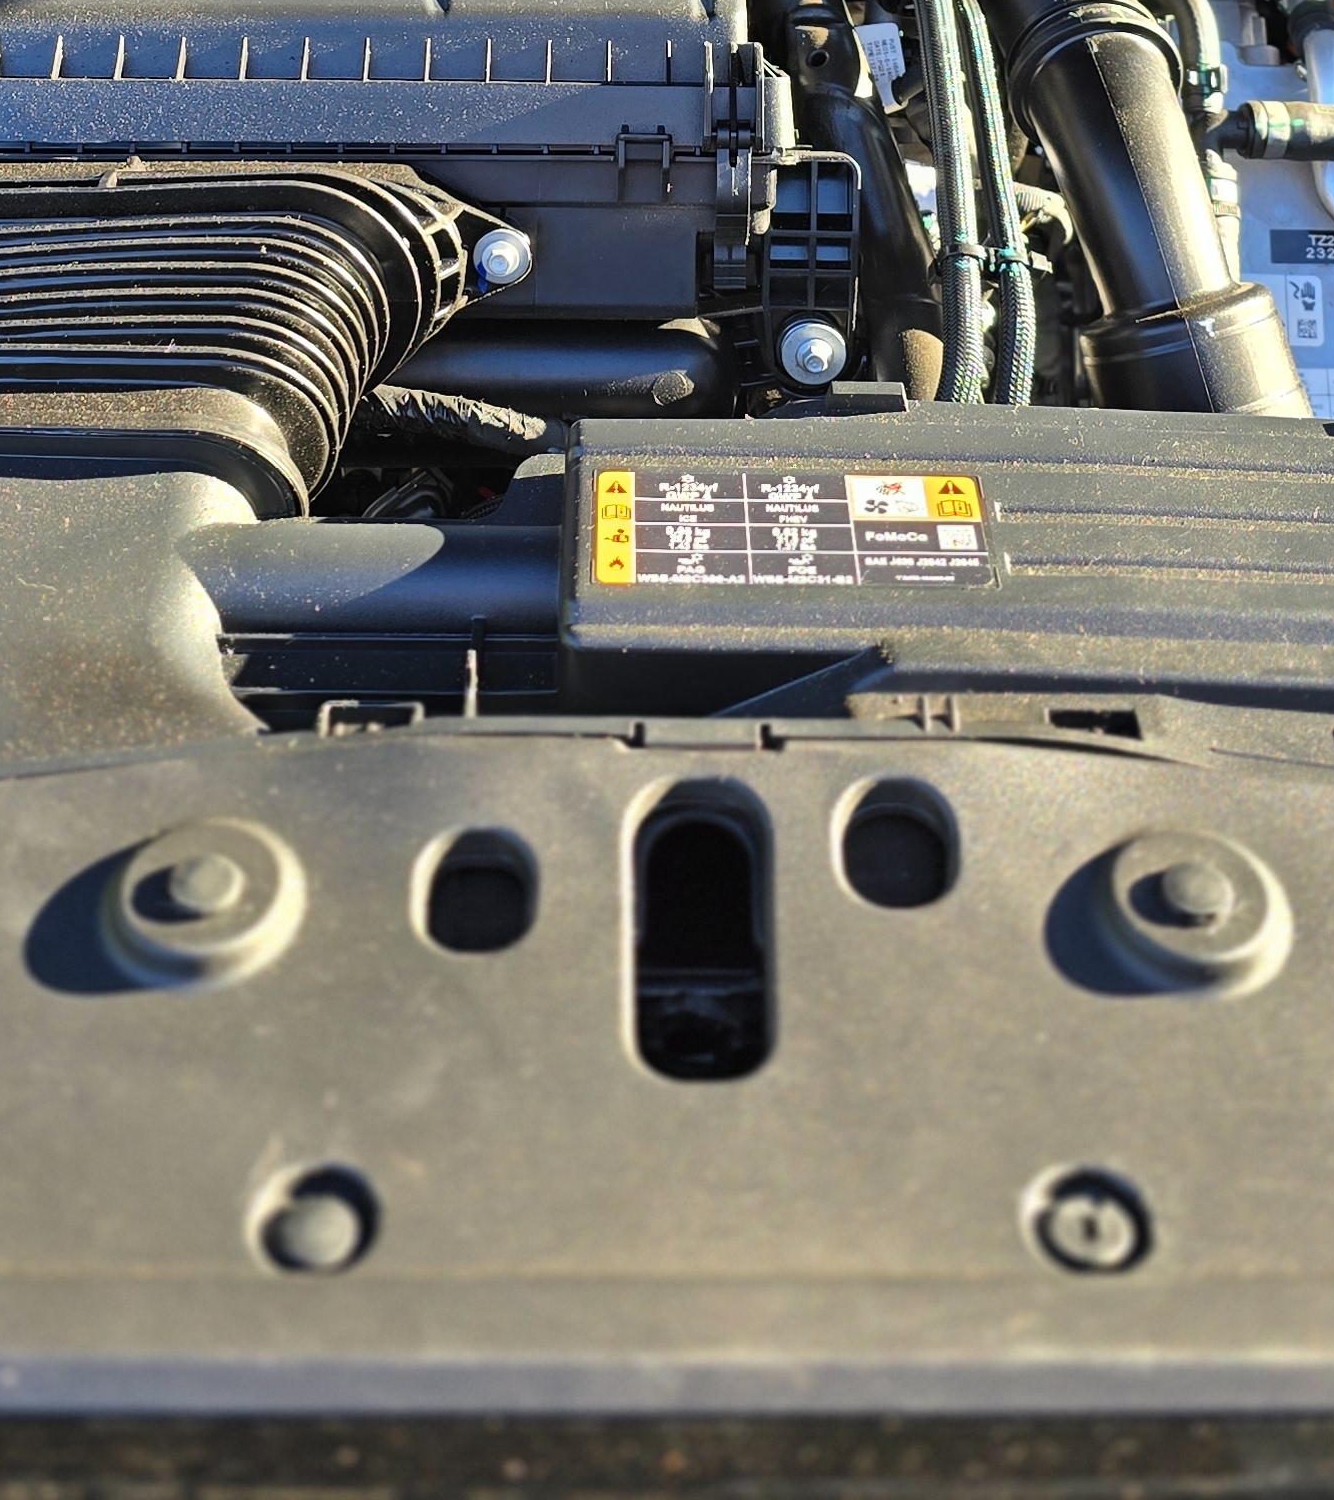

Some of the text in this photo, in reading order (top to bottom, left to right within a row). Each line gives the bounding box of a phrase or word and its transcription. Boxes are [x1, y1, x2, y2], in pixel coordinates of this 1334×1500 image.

[660, 503, 714, 512] NAUTILUS
[765, 504, 819, 512] NAUTILUS
[679, 514, 697, 522] ICE
[779, 515, 807, 523] PHEV
[865, 531, 928, 541] FoMoCo
[677, 565, 705, 574] PAG
